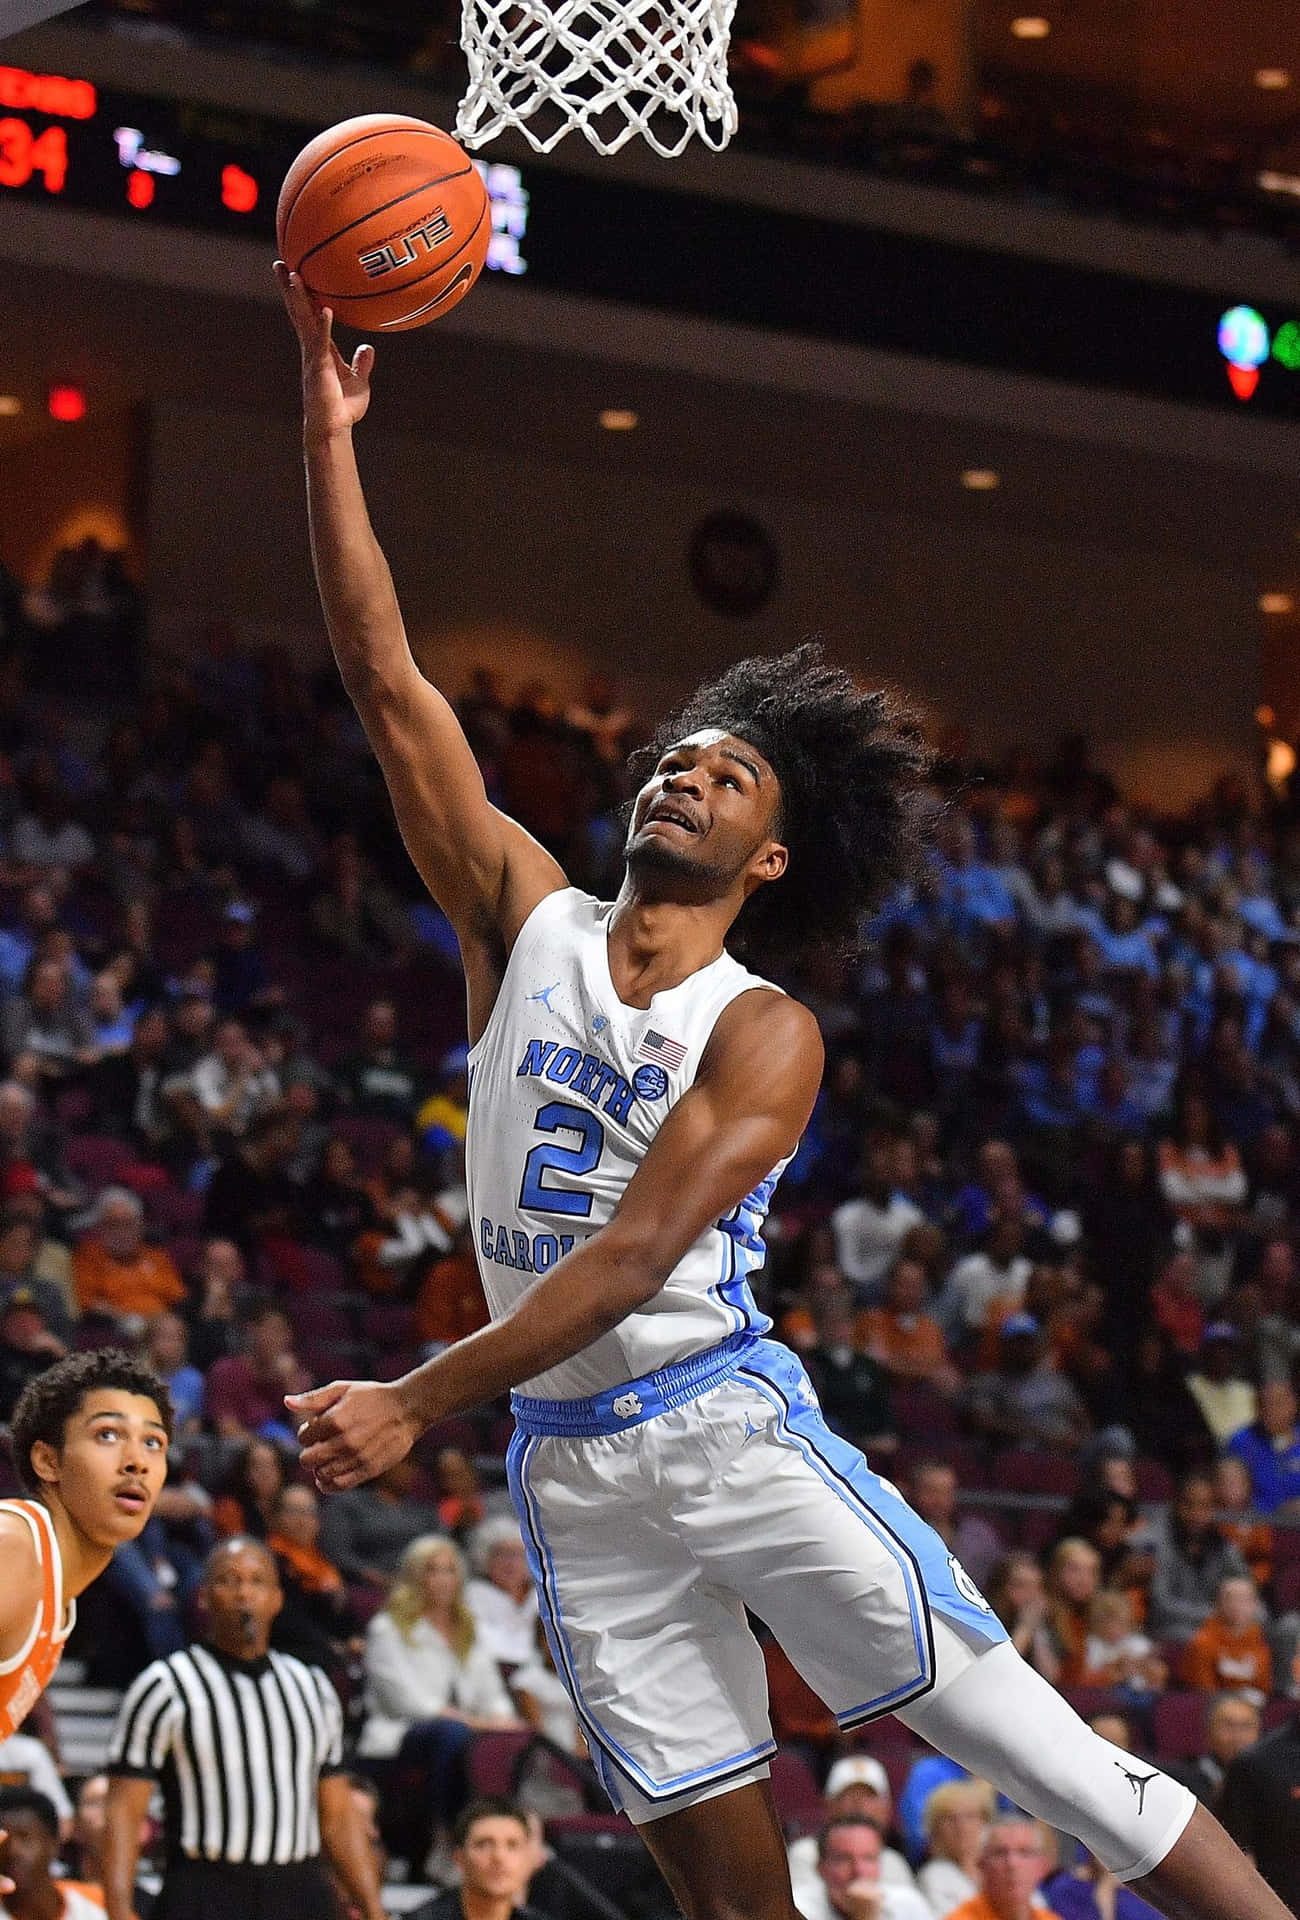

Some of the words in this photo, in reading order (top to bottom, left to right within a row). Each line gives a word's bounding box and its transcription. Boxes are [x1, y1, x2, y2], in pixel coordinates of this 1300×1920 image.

[359, 213, 454, 278] ELITE
[516, 1039, 636, 1128] NORTH
[638, 1074, 665, 1089] ACC
[518, 1100, 604, 1217] 2
